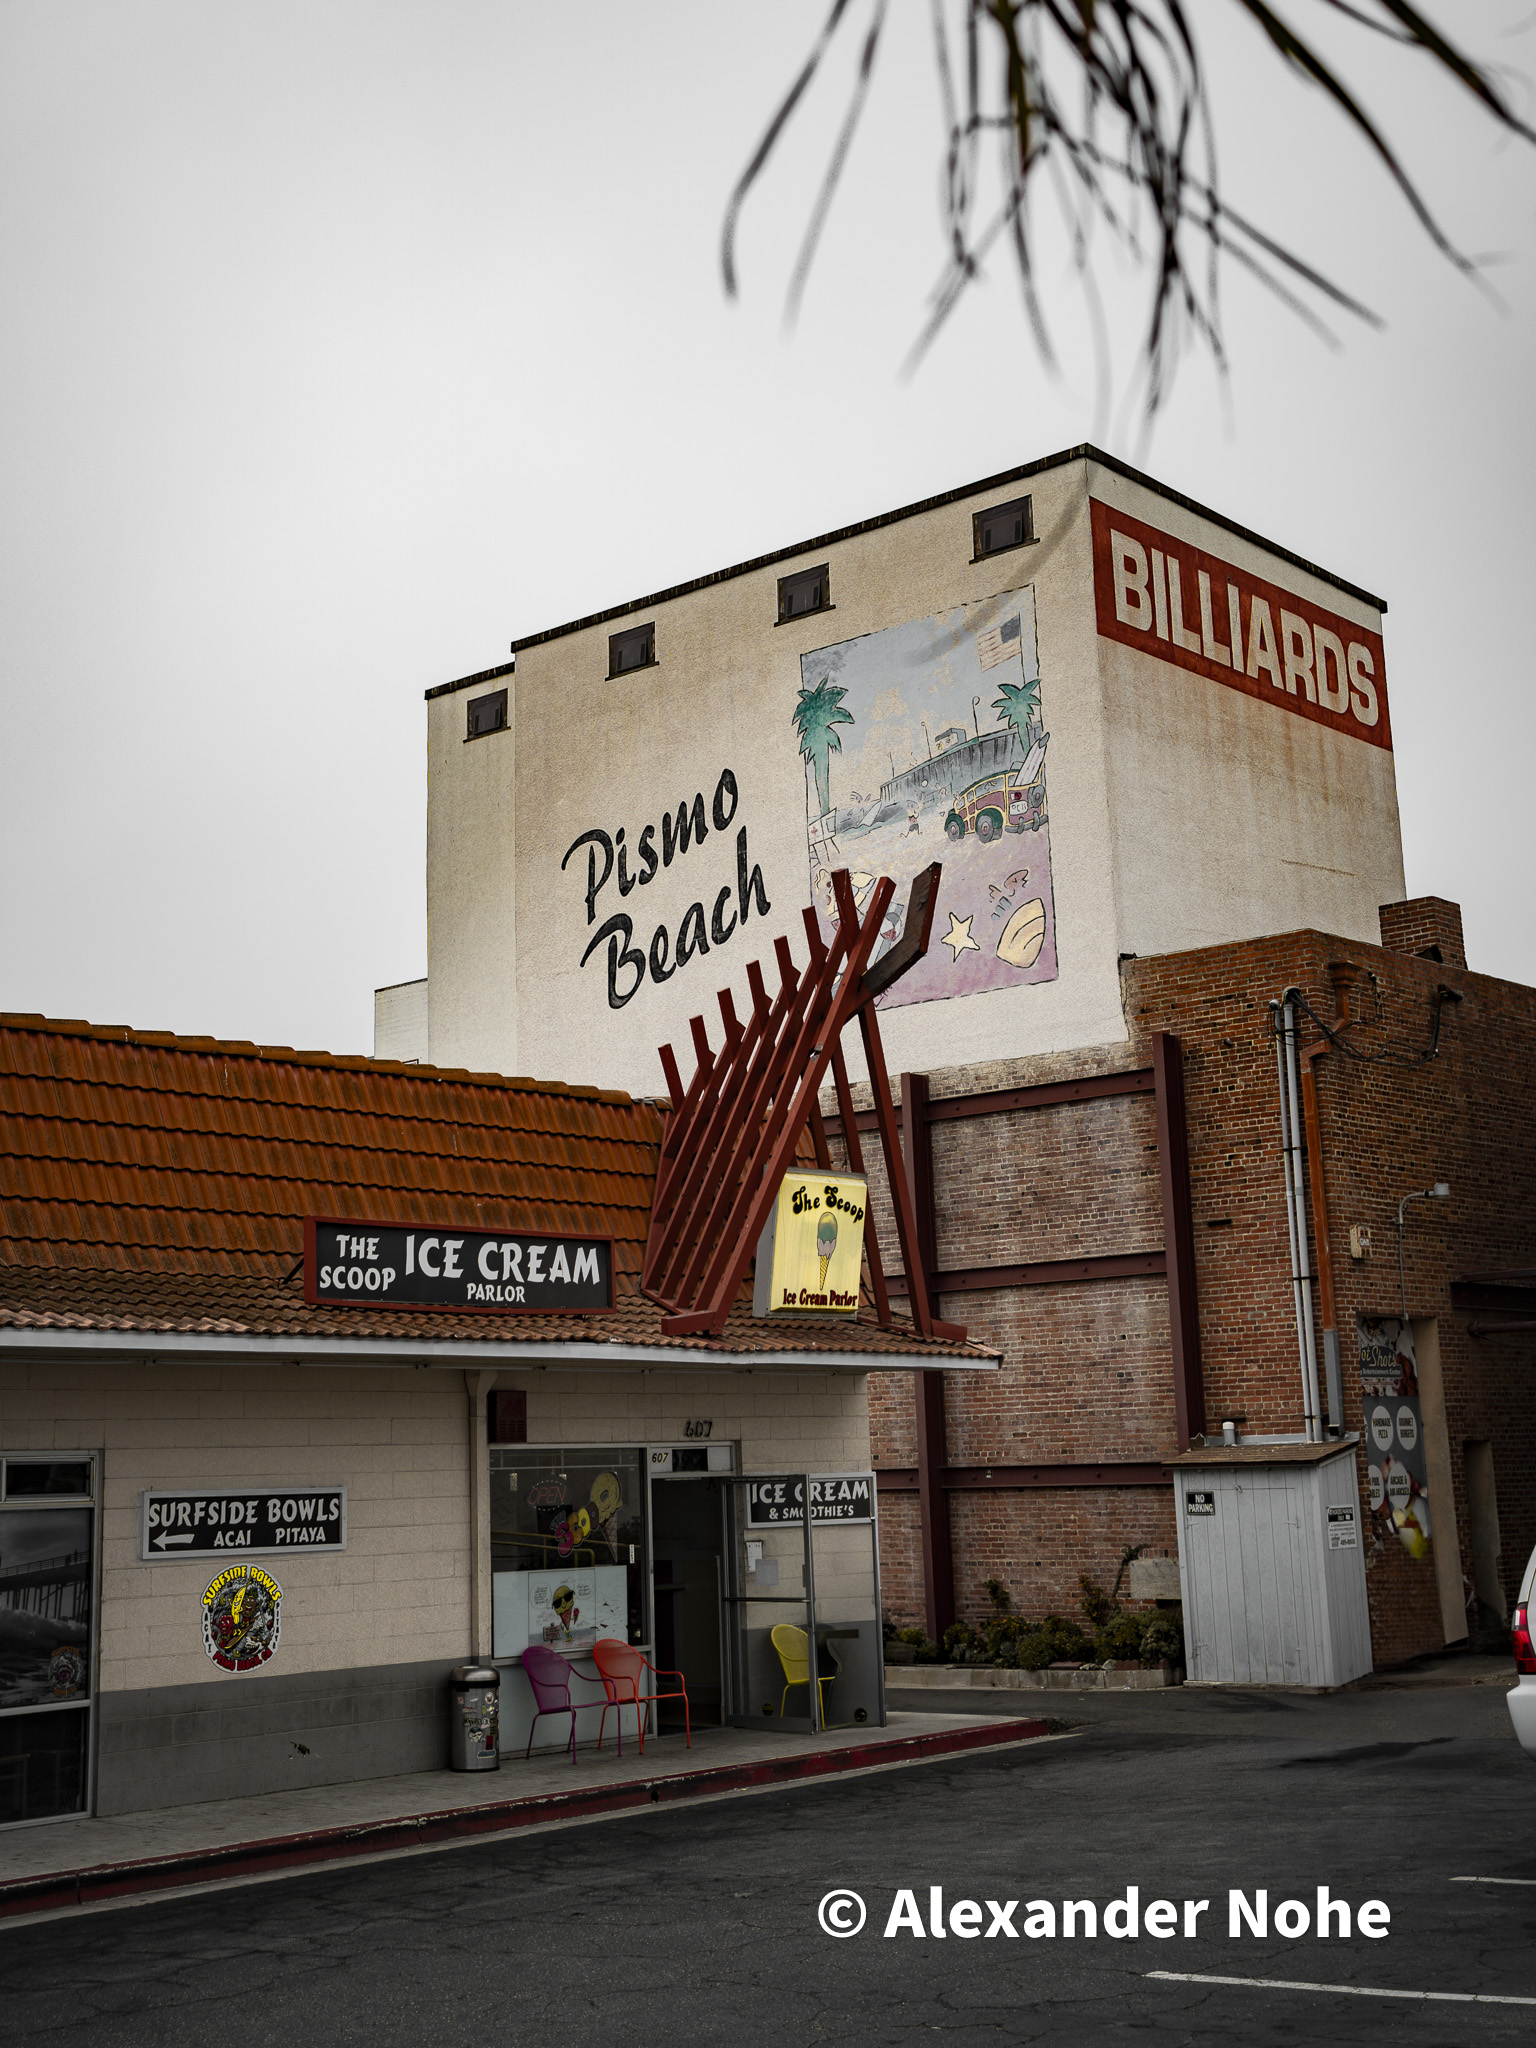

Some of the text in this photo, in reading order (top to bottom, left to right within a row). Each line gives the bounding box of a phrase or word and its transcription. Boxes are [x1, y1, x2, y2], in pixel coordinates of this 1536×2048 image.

[1110, 528, 1379, 727] BILLIARDS
[561, 768, 738, 925] Pismo
[580, 825, 771, 1009] Beach
[792, 1185, 864, 1223] The Scoop
[336, 1234, 380, 1260] THE
[405, 1234, 600, 1285] ICE CREAM
[319, 1265, 396, 1291] SCOOP
[467, 1282, 525, 1303] PARLOR
[783, 1288, 858, 1306] Ice Cream Parlor
[1369, 1345, 1397, 1367] Shots
[684, 1420, 713, 1438] 607
[652, 1452, 668, 1463] 607
[528, 1485, 567, 1505] OPEN
[752, 1480, 869, 1504] ICE CREAM
[1195, 1494, 1205, 1503] NO
[149, 1498, 340, 1528] SURFSIDE BOWLS
[769, 1507, 778, 1519] &
[1188, 1503, 1213, 1512] PARKING
[213, 1526, 326, 1547] ACAI PITAYA
[203, 1565, 282, 1607] SURFSIDE BOWLS
[213, 1651, 236, 1671] PISMO
